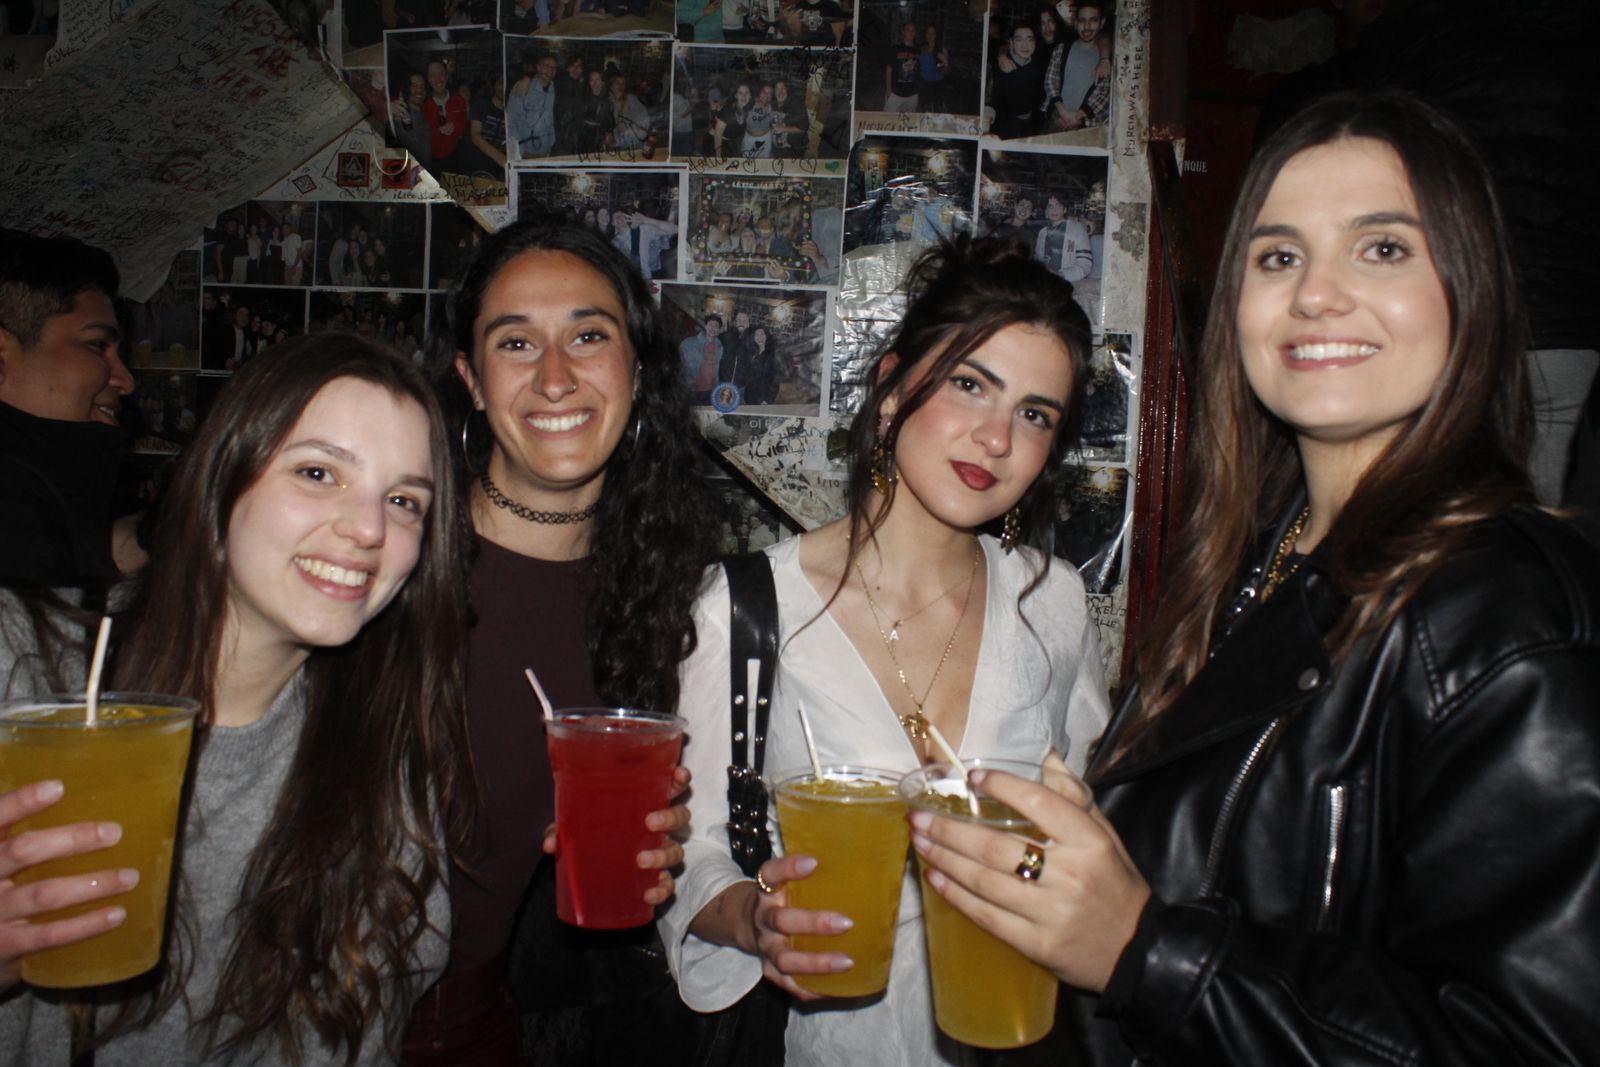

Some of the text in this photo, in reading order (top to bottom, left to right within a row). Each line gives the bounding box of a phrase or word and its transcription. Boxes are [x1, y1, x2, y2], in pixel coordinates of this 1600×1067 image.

[1121, 45, 1144, 157] MURCIA WAS HERE
